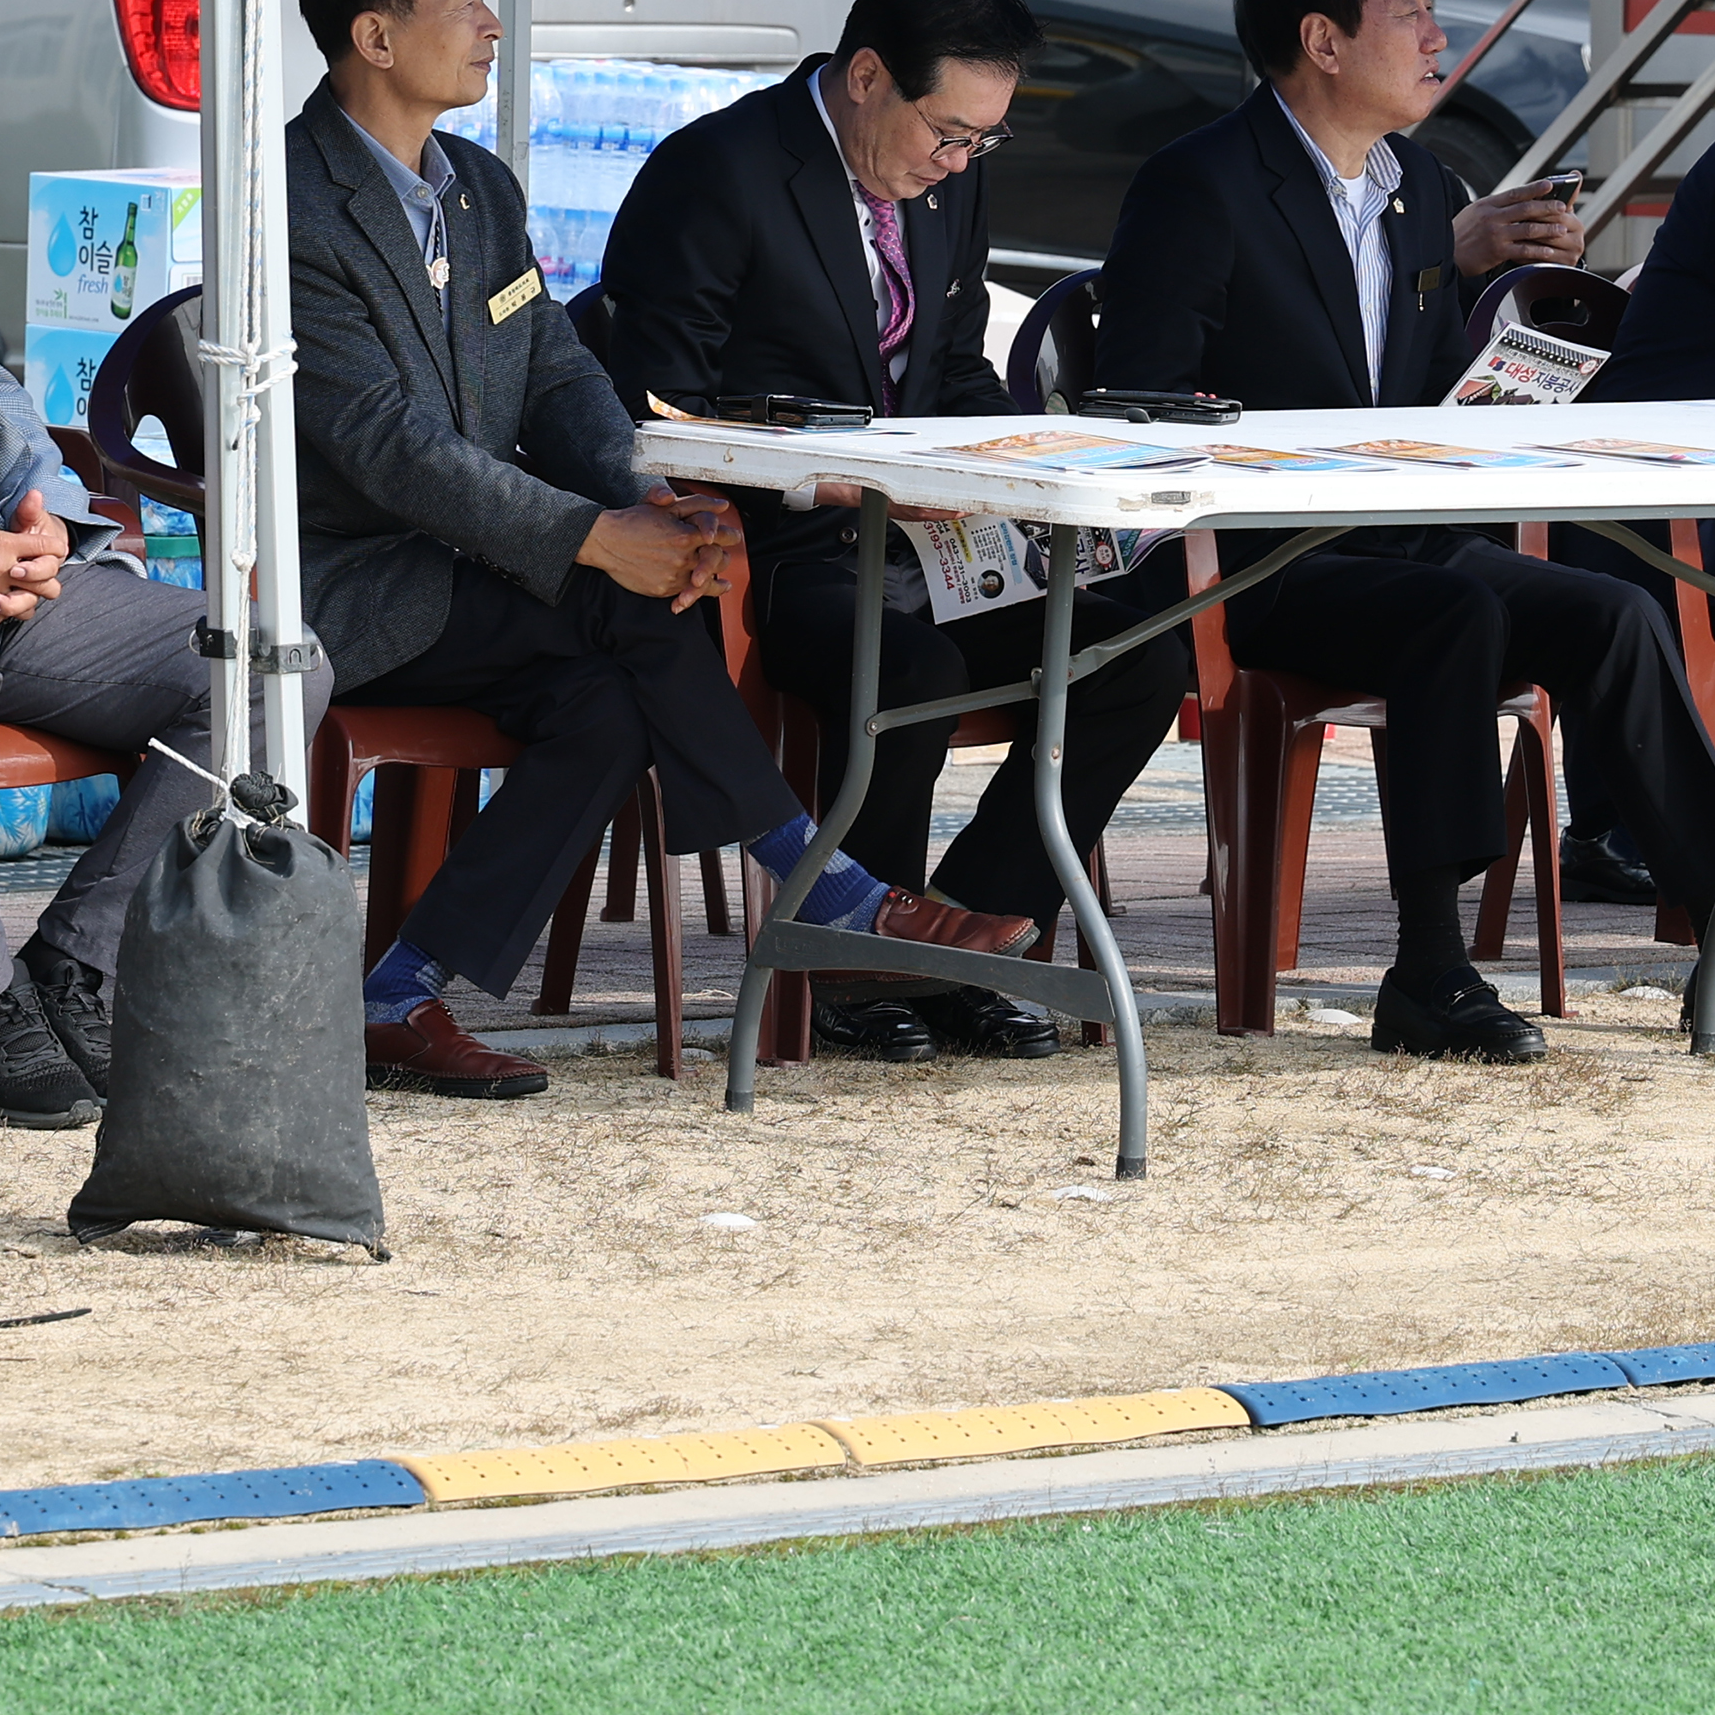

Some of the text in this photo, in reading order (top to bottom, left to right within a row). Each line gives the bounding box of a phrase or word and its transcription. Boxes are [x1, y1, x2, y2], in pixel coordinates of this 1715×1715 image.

[78, 205, 99, 241] 참
[78, 240, 114, 276] 이슬
[77, 274, 109, 294] fresh
[1504, 361, 1538, 383] 대성
[1531, 371, 1581, 396] 지붕공사
[923, 521, 955, 590] 3193-3344
[949, 538, 971, 603] 043-731-3003
